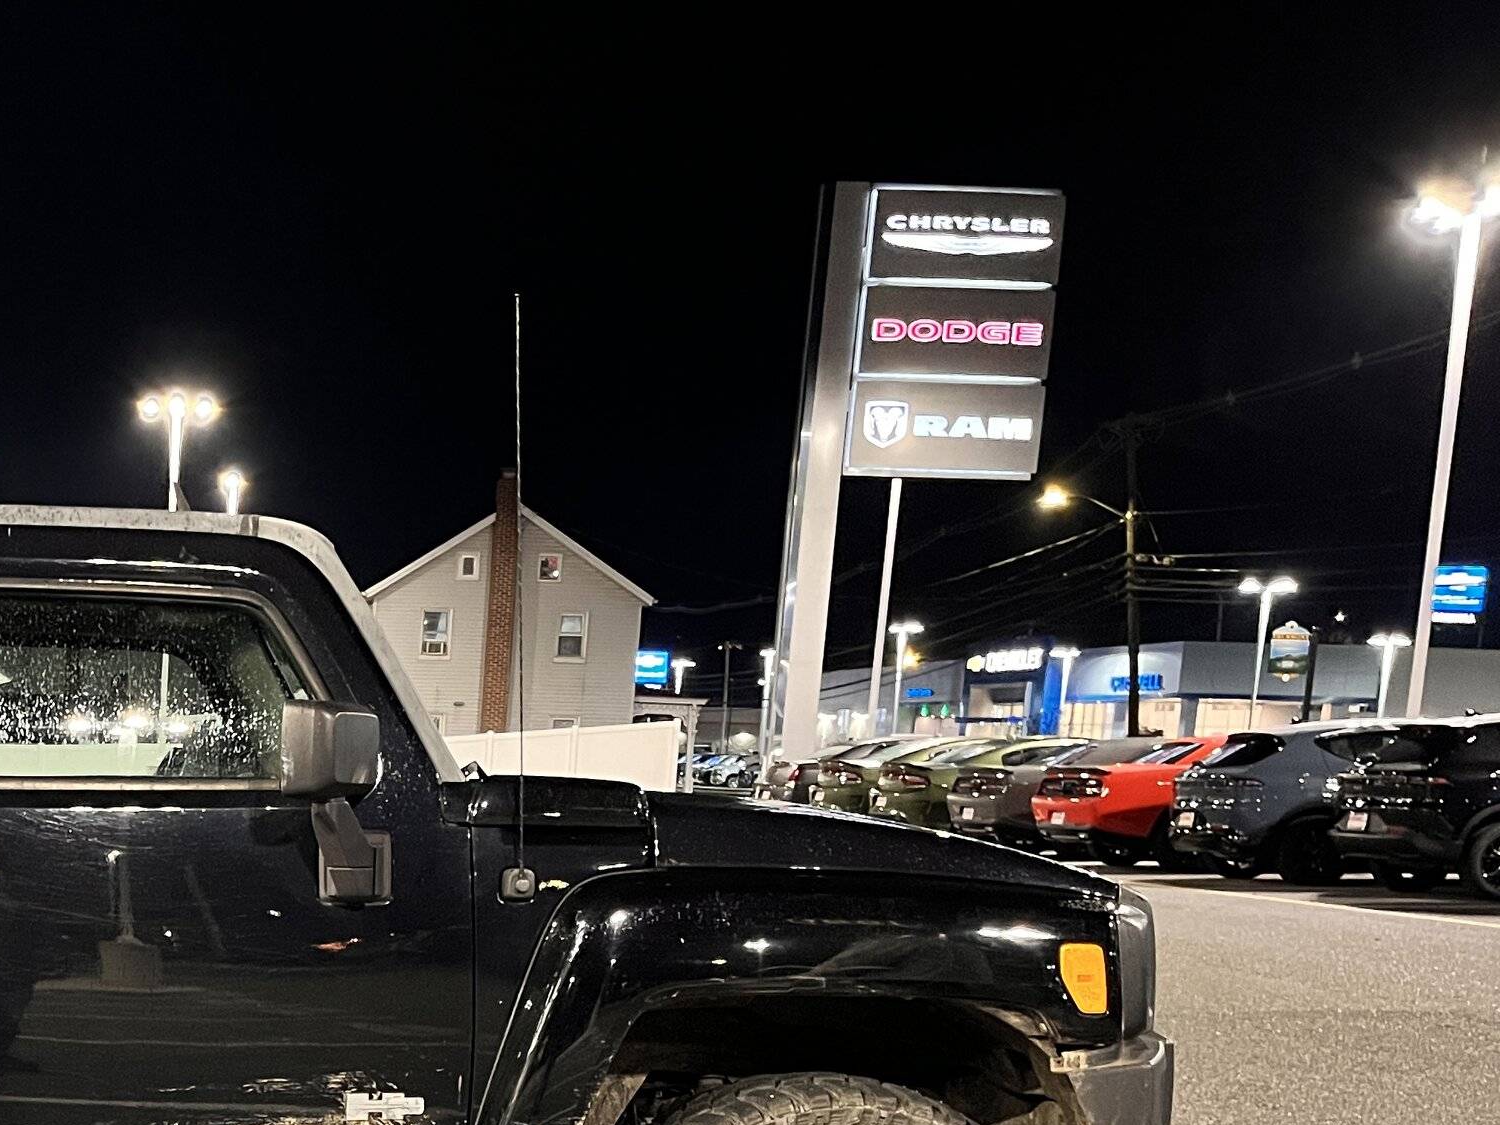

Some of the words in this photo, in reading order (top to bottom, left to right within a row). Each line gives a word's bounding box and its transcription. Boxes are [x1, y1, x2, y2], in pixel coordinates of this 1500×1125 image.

[886, 214, 1051, 234] CHRYSLER
[871, 318, 1044, 347] DODGE
[913, 415, 1033, 441] RAM
